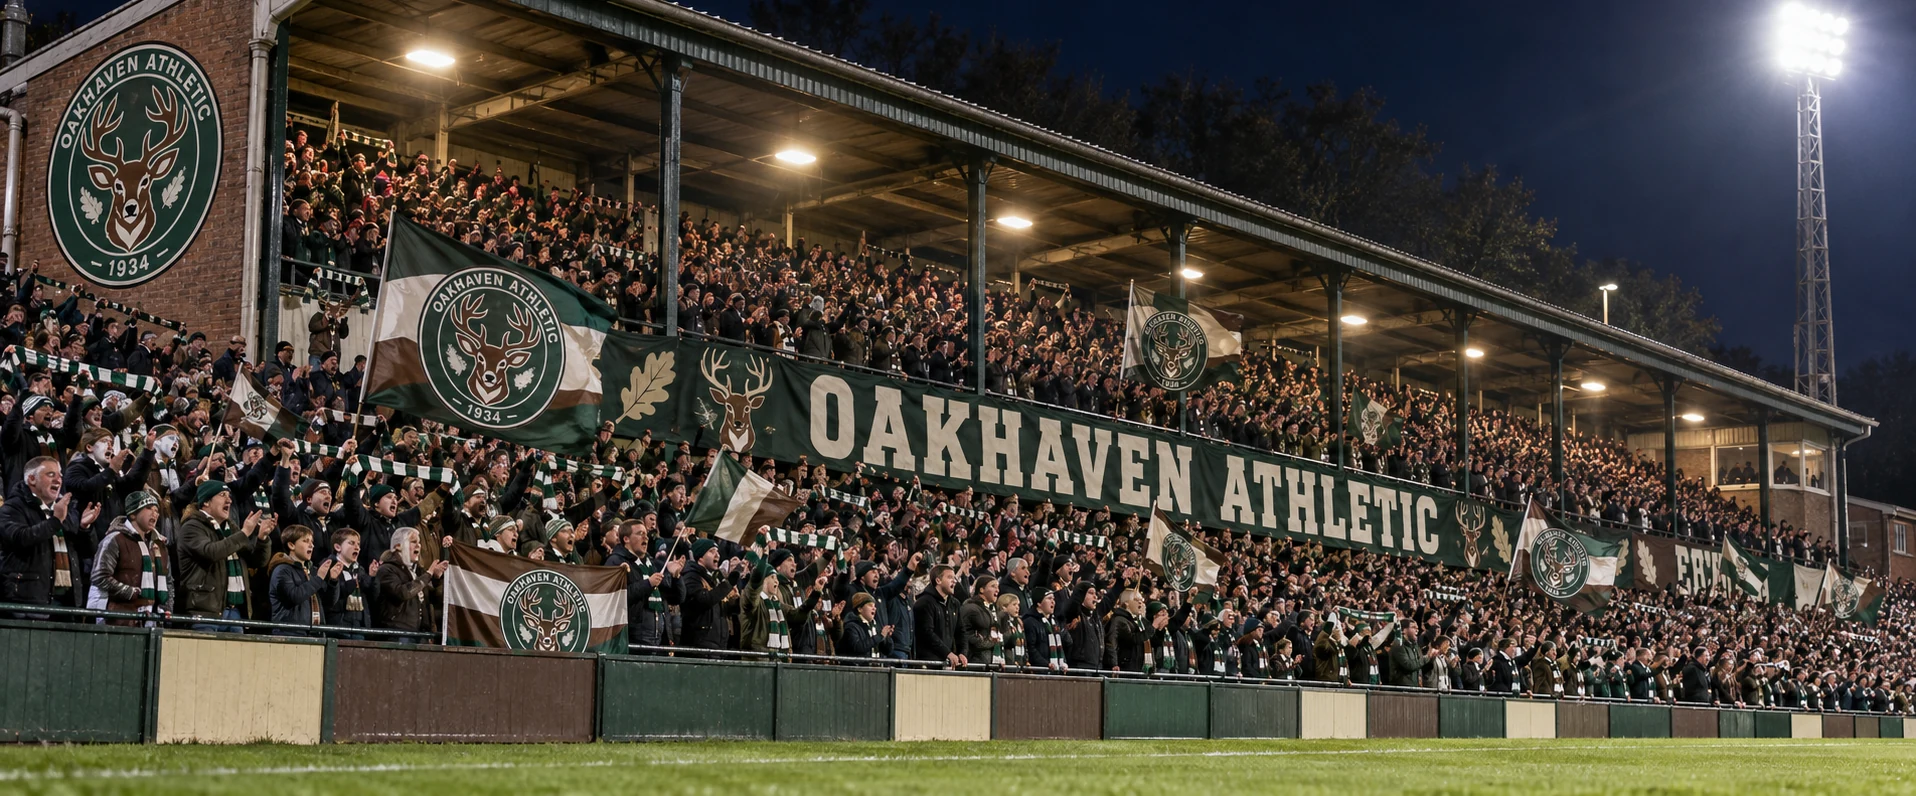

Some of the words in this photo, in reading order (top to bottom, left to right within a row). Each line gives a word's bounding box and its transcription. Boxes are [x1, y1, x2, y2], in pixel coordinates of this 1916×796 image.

[61, 55, 139, 149] OAKHAVEN
[145, 53, 211, 121] ATHLETIC
[109, 254, 150, 277] 1934
[433, 272, 503, 313] OAKHAVEN
[508, 279, 559, 343] ATHLETIC
[467, 404, 501, 424] 1934
[809, 374, 1192, 515] OAKHAVEN
[1220, 454, 1439, 555] ATHLETIC
